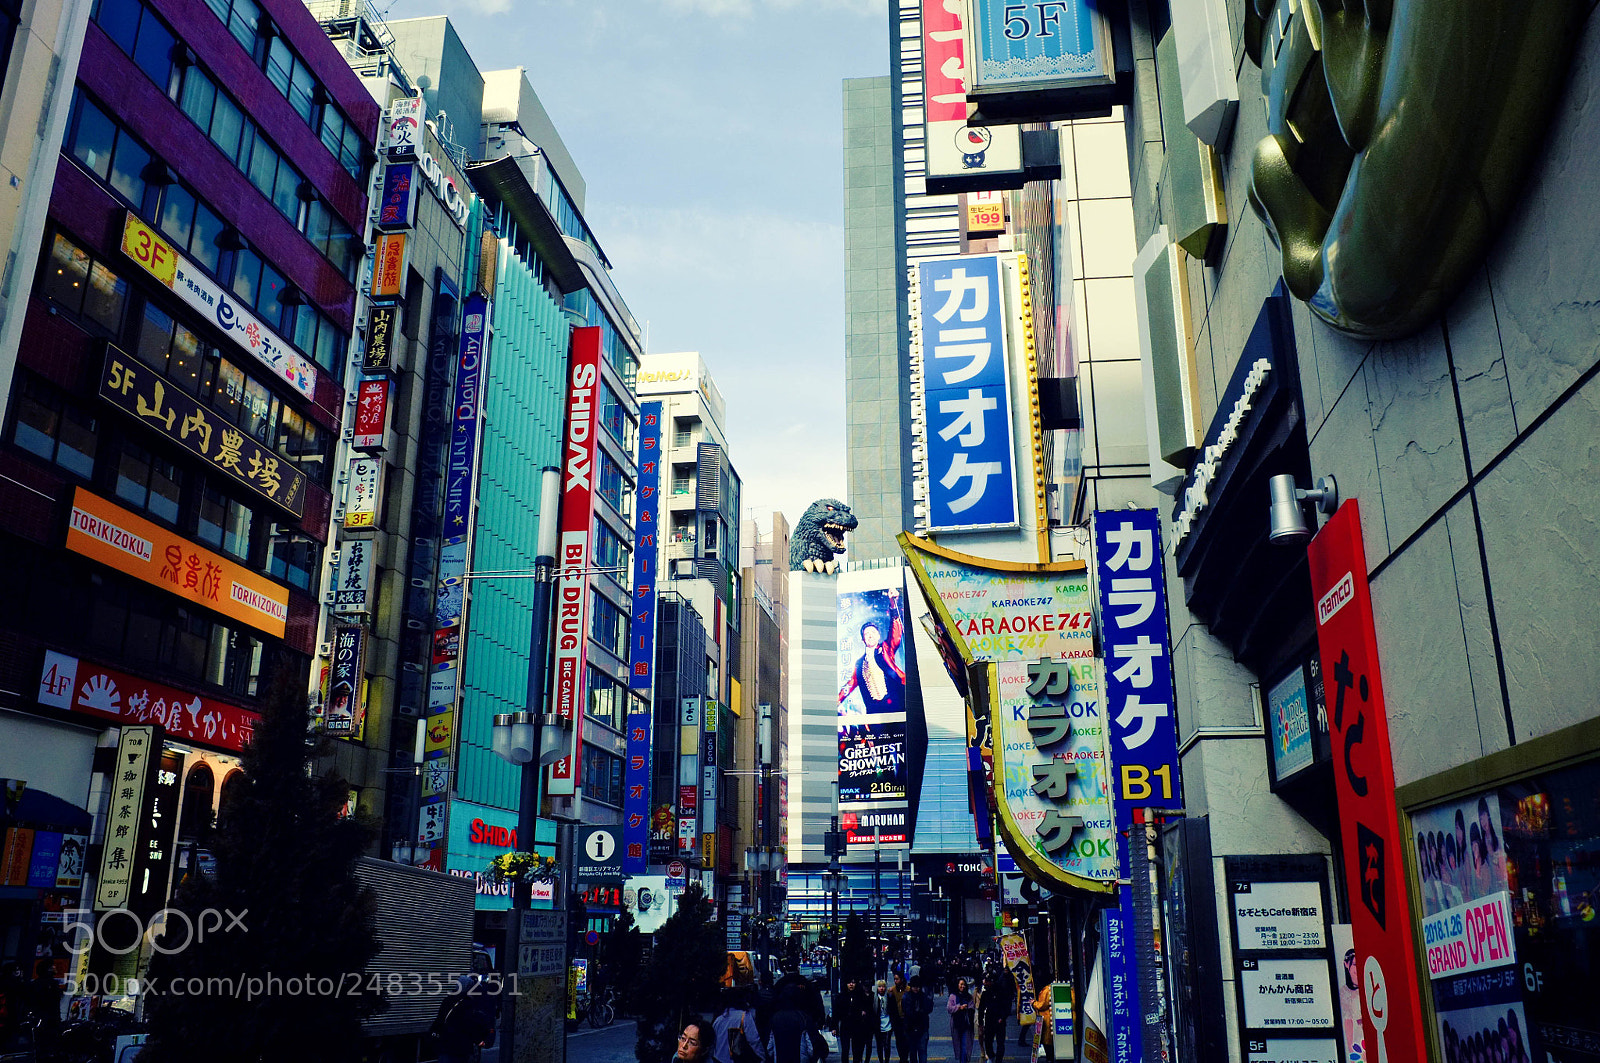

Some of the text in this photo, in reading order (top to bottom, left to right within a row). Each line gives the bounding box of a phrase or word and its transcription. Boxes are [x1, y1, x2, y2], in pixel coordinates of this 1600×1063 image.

[1003, 1, 1067, 40] 5F
[395, 146, 407, 155] 8F
[970, 206, 999, 214] 生ビール
[974, 213, 1000, 224] 199
[134, 230, 168, 270] 3F
[369, 309, 390, 360] 山内農場
[108, 360, 136, 396] 5F
[932, 267, 1003, 515] カラオケ
[136, 379, 282, 498] 山内農場
[361, 435, 375, 447] 4F
[566, 363, 596, 493] SHIDAX
[72, 508, 145, 556] TORIKIZOKU
[353, 513, 368, 525] 3F
[232, 583, 283, 619] TORIKIZOKU
[560, 543, 583, 650] BIC DRUG
[1319, 575, 1353, 619] namco
[1105, 521, 1168, 751] カラオケ
[336, 632, 356, 678] 海の家
[563, 660, 572, 678] BIC
[41, 662, 71, 697] 4F
[839, 753, 905, 772] SHOWMAN
[844, 742, 903, 759] GREATEST
[1026, 656, 1084, 853] カラオケ
[627, 727, 646, 858] カラオケ館
[870, 782, 892, 793] 2.16
[1121, 763, 1173, 800] B1
[861, 813, 905, 827] MARUHAN
[107, 890, 119, 899] 2F
[1238, 907, 1318, 918] なぞともCafe新宿店
[1424, 913, 1463, 945] 2018.1.26
[1428, 900, 1510, 975] GRAND OPEN
[1243, 960, 1255, 968] 6F
[1523, 962, 1544, 993] 6F
[1258, 984, 1314, 994] かんかん商店
[1249, 1041, 1264, 1051] 5F
